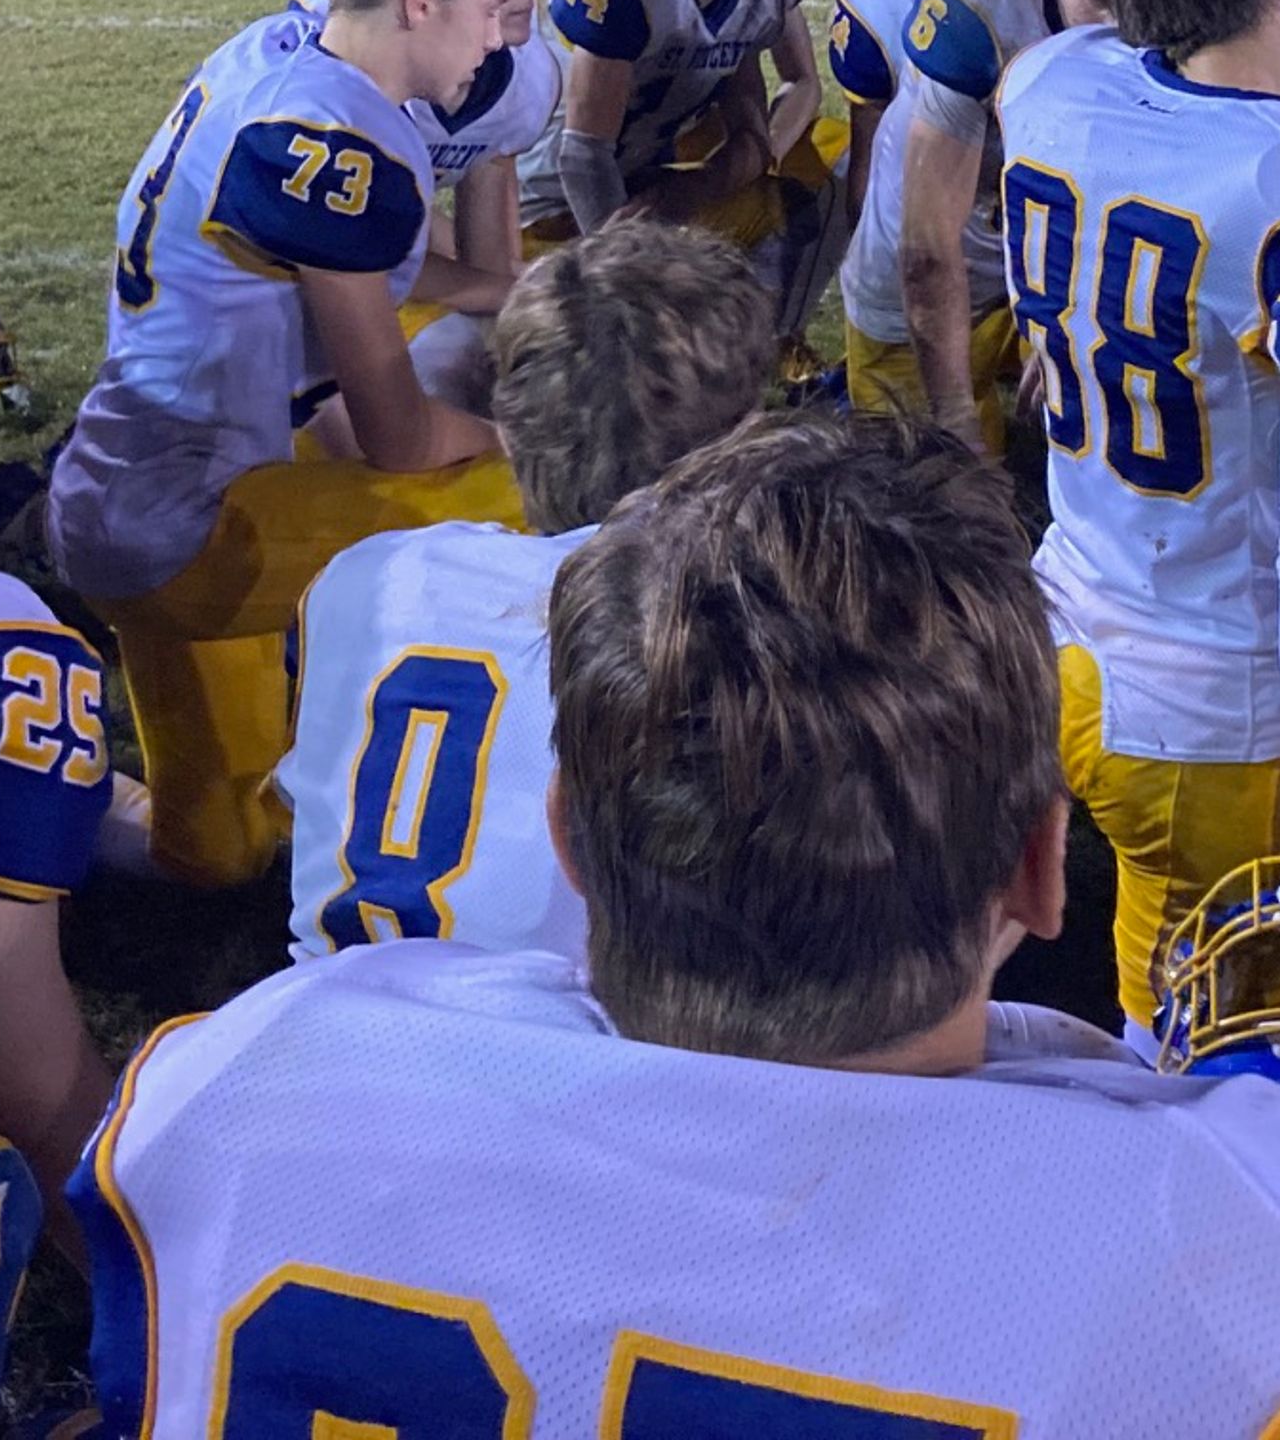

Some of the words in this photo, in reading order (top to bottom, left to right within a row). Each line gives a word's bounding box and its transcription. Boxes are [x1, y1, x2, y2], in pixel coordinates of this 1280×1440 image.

[281, 133, 375, 216] 73
[426, 143, 489, 169] INCENT
[1000, 156, 1215, 503] 88
